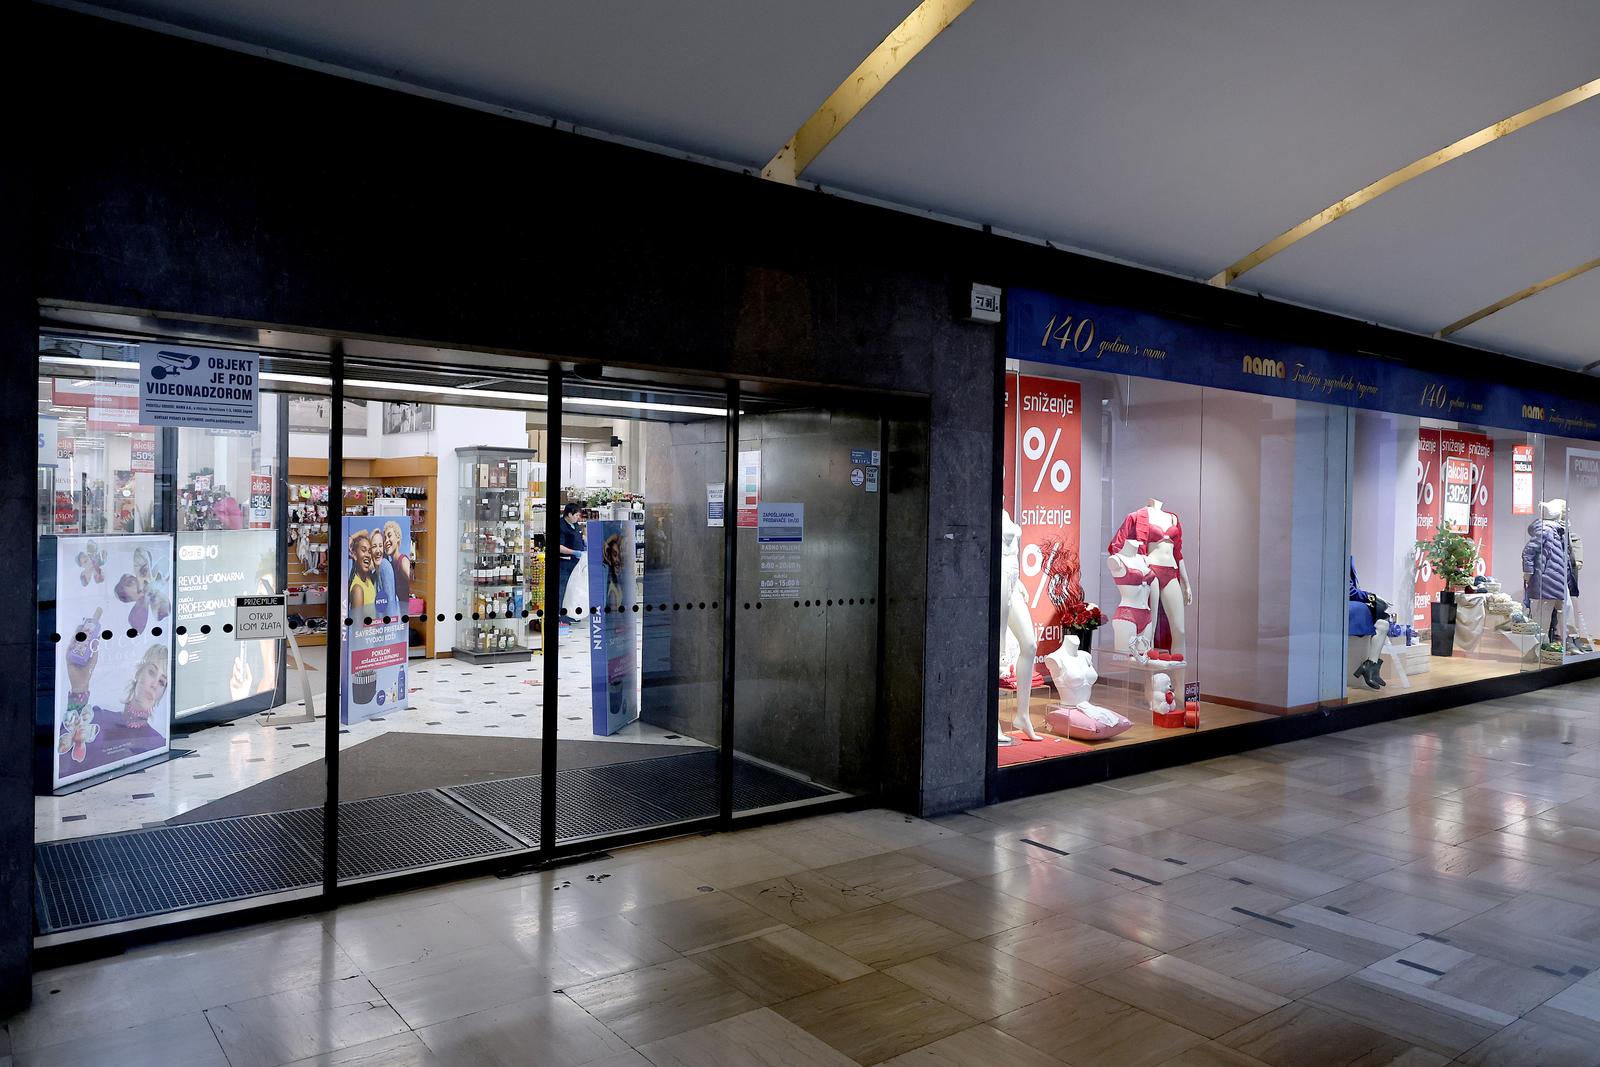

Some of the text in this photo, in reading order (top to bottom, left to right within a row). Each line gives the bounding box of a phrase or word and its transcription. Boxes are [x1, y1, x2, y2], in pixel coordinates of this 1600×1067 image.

[1041, 314, 1095, 353] 140
[1096, 336, 1131, 359] godina
[208, 357, 253, 372] OBJEKT
[1242, 355, 1286, 379] nama
[210, 372, 253, 386] JE POD
[146, 382, 252, 401] VIDEONADZOROM
[1420, 383, 1447, 409] 140
[1023, 392, 1074, 418] sniženje
[1521, 404, 1545, 421] nama
[1442, 438, 1465, 455] sniženje
[1023, 426, 1072, 493] %
[1448, 462, 1468, 482] akcija
[1447, 484, 1469, 502] -30%
[1021, 504, 1072, 528] sniženje
[178, 572, 246, 587] REVOLUCIONARNA
[243, 597, 278, 606] PRIZEMLJE
[248, 612, 274, 621] OTKUP
[240, 621, 282, 631] LOM ZLATA
[592, 605, 602, 650] NIVEA
[1034, 621, 1063, 644] iženj
[371, 648, 391, 657] POKLON
